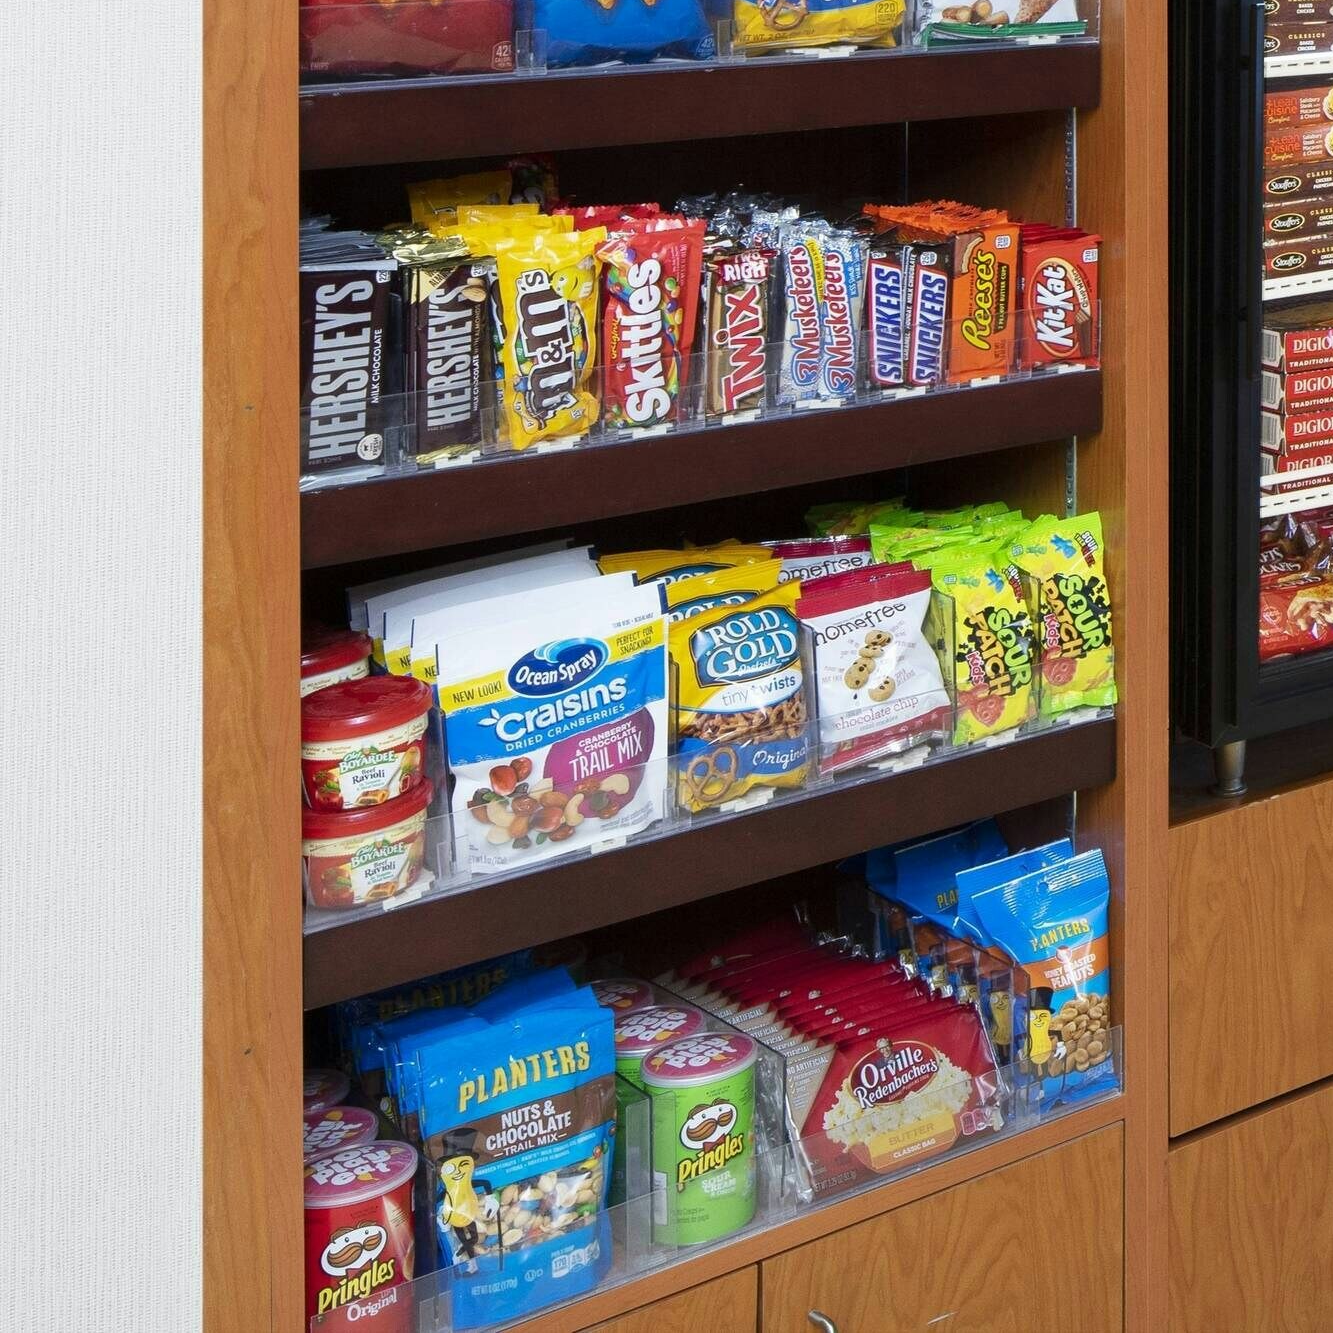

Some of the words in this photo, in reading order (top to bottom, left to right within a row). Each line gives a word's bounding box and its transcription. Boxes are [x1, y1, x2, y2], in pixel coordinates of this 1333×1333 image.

[789, 246, 820, 360] Musketeers
[824, 253, 853, 367] Musketeers
[961, 249, 996, 351] Reese's
[619, 258, 671, 423] Skittles
[874, 267, 902, 380] SNICKERS
[915, 273, 947, 381] SNICKERS
[308, 279, 374, 461] HERSHEY'S
[370, 328, 383, 382] CHOCOLATE
[427, 284, 473, 427] HERSHEY'S
[370, 381, 381, 405] MILK
[1282, 477, 1331, 490] TRADITIONAL
[778, 555, 864, 584] omefree
[706, 608, 782, 649] ROLD
[1043, 580, 1083, 658] PATCH
[1044, 614, 1062, 649] Kids
[1059, 575, 1105, 650] SOUR
[615, 630, 641, 647] PERFECT
[642, 625, 654, 637] FOR
[619, 637, 652, 656] SNACKING!
[706, 631, 796, 679] GOLD
[971, 614, 1012, 696] PATCH
[988, 608, 1032, 686] SOUR
[515, 665, 557, 686] Ocean
[559, 649, 598, 682] Spray
[965, 651, 985, 686] Kids
[452, 688, 475, 704] NEW
[477, 681, 503, 698] LOOK!
[721, 688, 749, 707] tiny
[505, 734, 543, 752] DRIED
[547, 703, 626, 738] CRANBERRIES
[578, 720, 634, 748] CRANBERRY
[834, 708, 891, 732] chocolate
[892, 696, 919, 718] chip
[569, 743, 614, 781] TRAIL
[616, 732, 643, 764] MIX
[584, 726, 637, 754] CHOCOLATE
[339, 751, 397, 773] BOYARDEE
[352, 769, 385, 785] Ravioli
[364, 861, 396, 878] Ravioli
[1031, 918, 1091, 952] PANTERS
[457, 1041, 592, 1113] PLANTERS
[853, 1058, 939, 1110] Redenbacher's
[860, 1046, 924, 1089] Orville
[485, 1111, 572, 1152] CHOCOLATE
[501, 1104, 541, 1129] NUTS
[543, 1099, 556, 1116] &
[888, 1122, 936, 1147] BUTTER
[503, 1140, 536, 1157] TRAIL
[537, 1134, 559, 1147] MIX
[677, 1133, 744, 1194] Pringles
[318, 1258, 395, 1322] Pringles
[346, 1287, 398, 1322] Original
